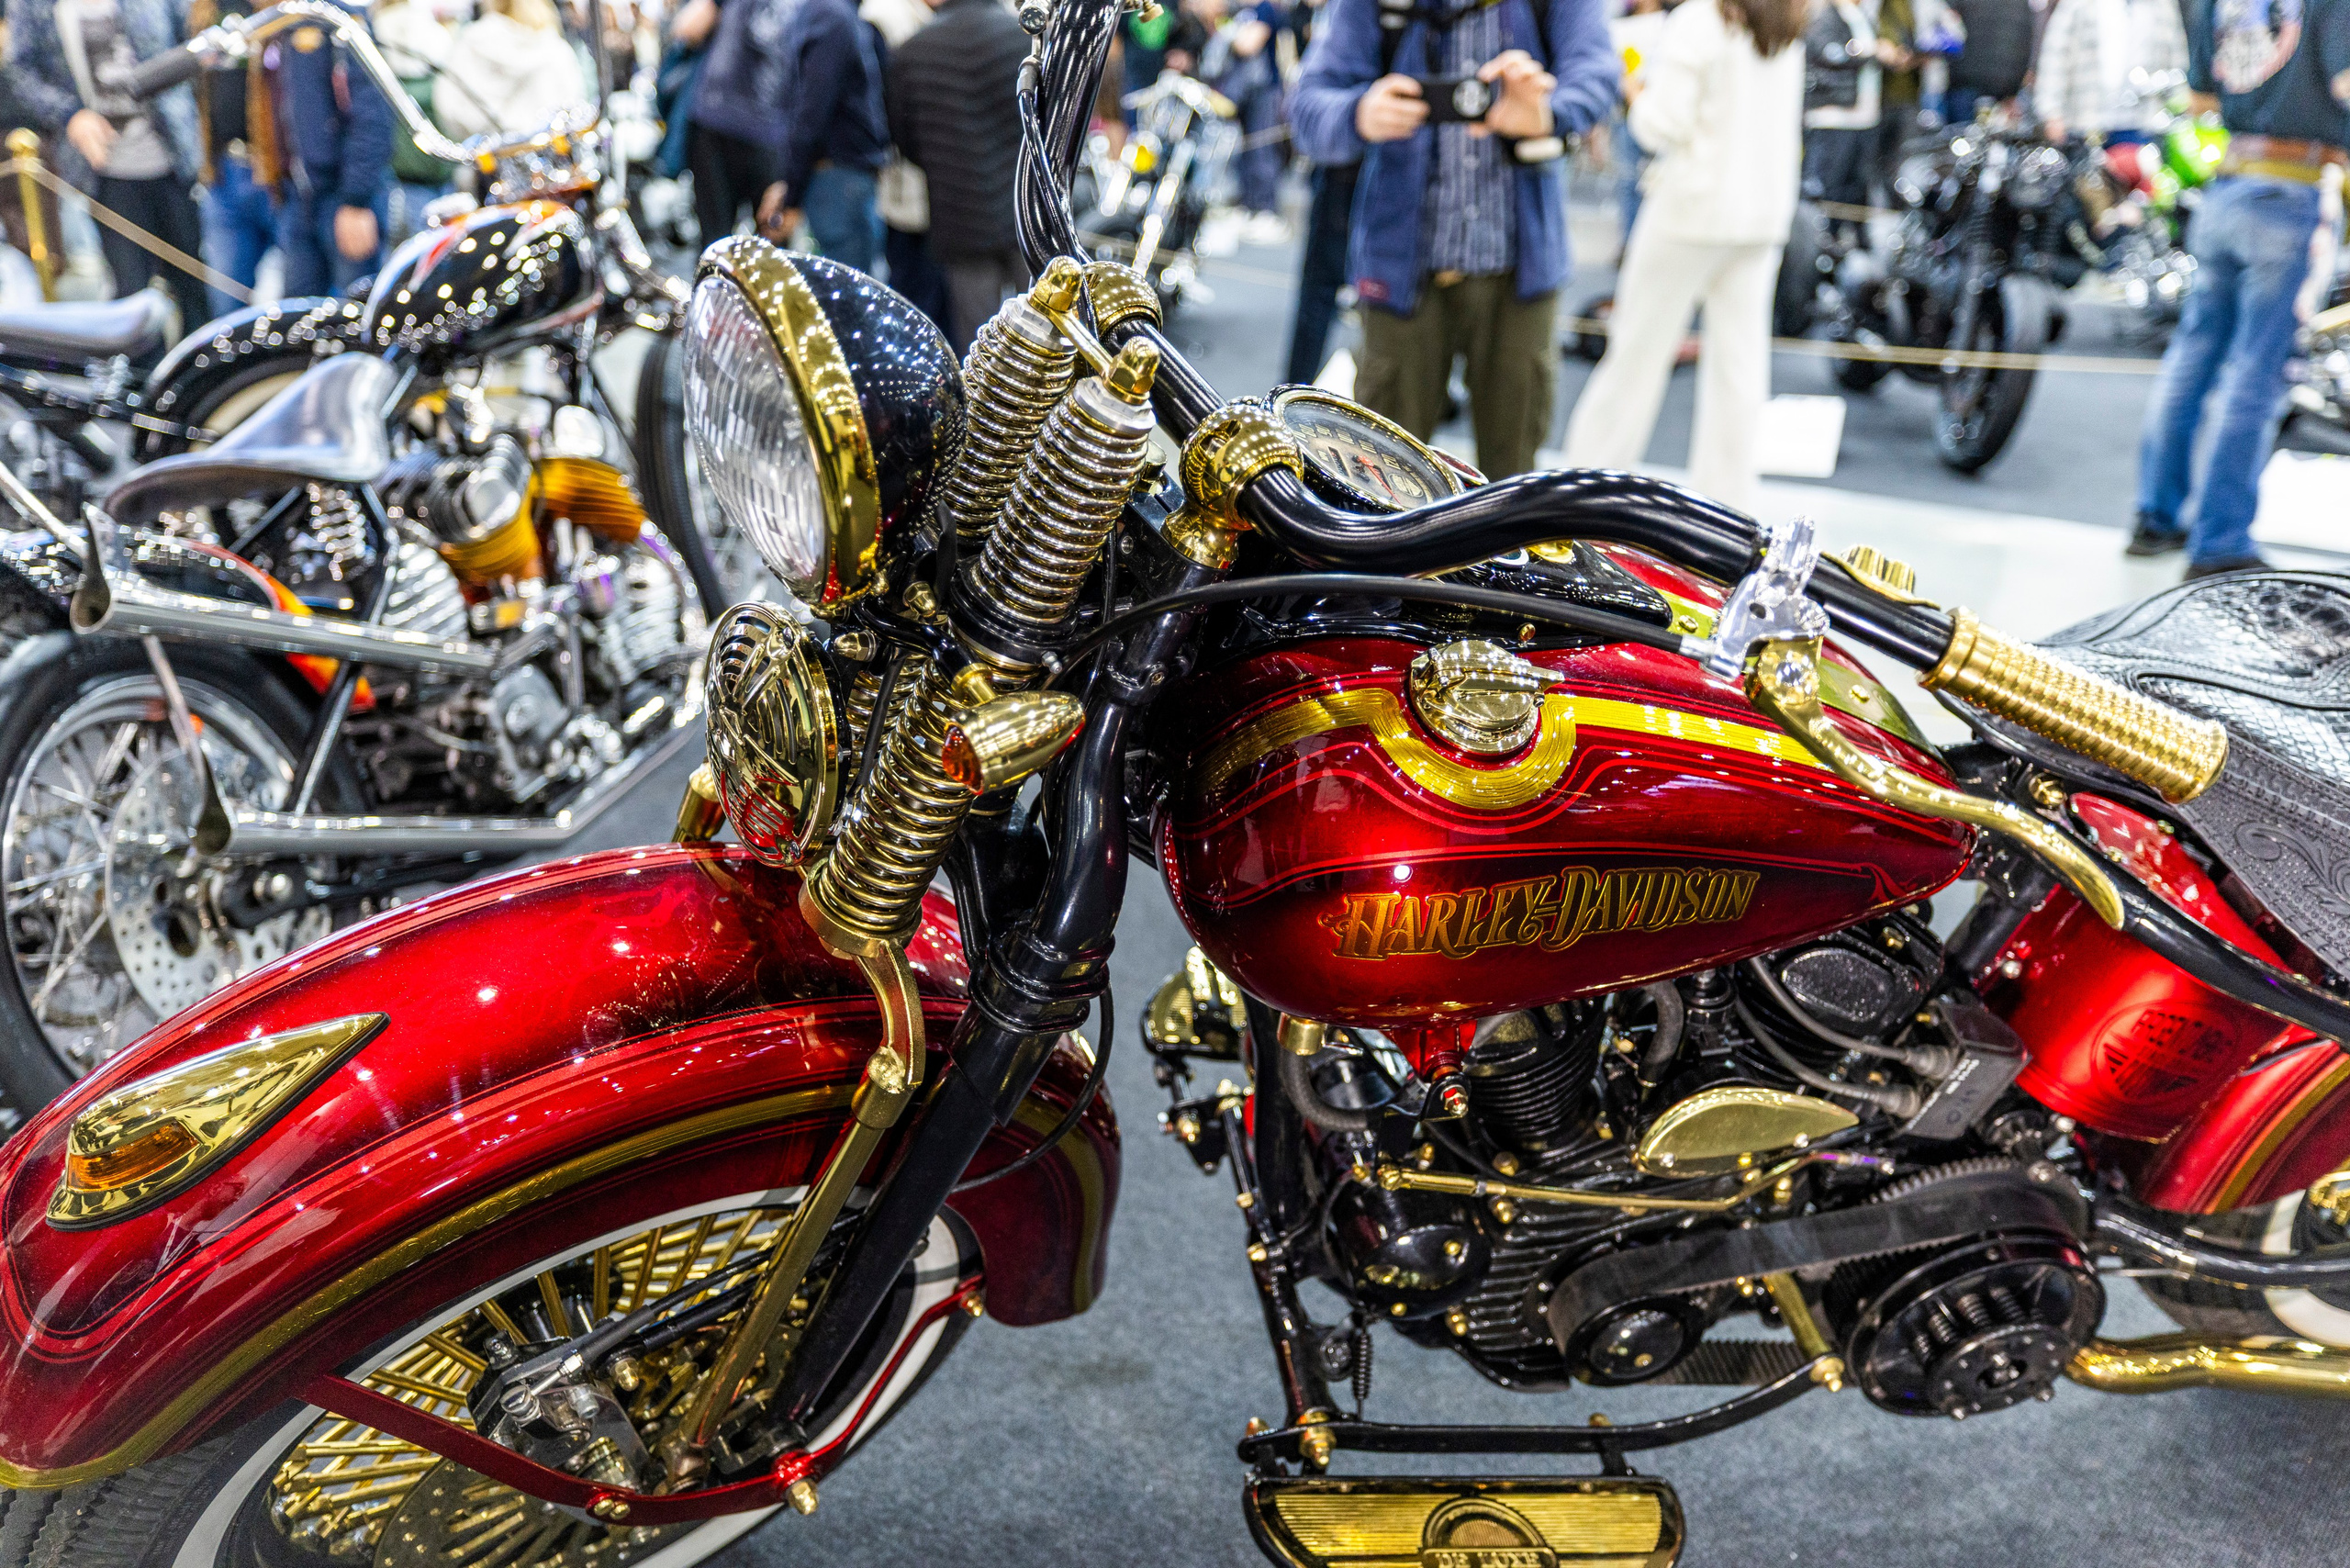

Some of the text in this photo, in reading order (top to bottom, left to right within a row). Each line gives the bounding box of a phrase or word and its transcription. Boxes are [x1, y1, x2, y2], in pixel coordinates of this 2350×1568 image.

[1317, 865, 1762, 961] HARLEY-DAVIDSON
[1435, 1551, 1542, 1568] DE LUXE
